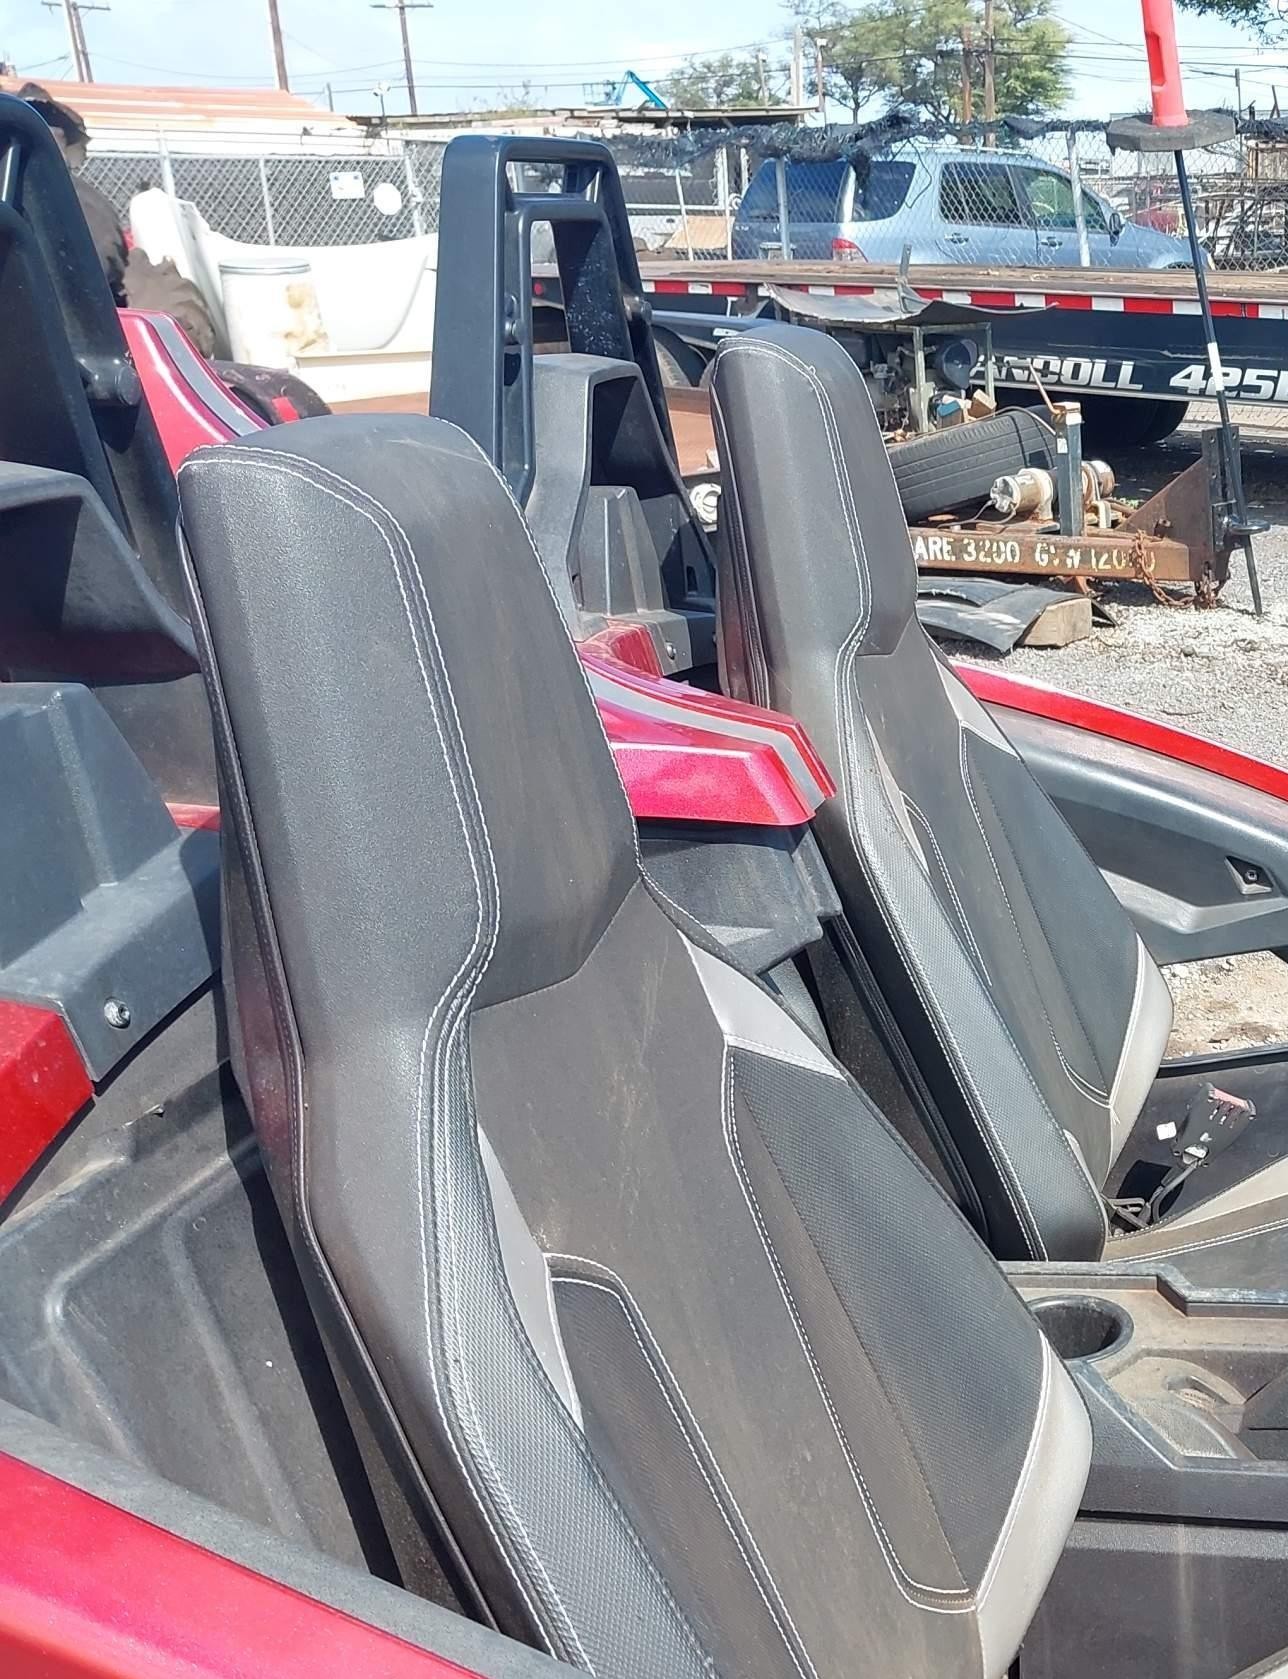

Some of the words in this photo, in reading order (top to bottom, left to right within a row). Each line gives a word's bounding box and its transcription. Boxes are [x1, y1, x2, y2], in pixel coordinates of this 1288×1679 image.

[969, 354, 1143, 391] ANDOLL
[914, 536, 955, 561] ARE
[962, 538, 1021, 564] 3200
[1090, 548, 1156, 572] 1200
